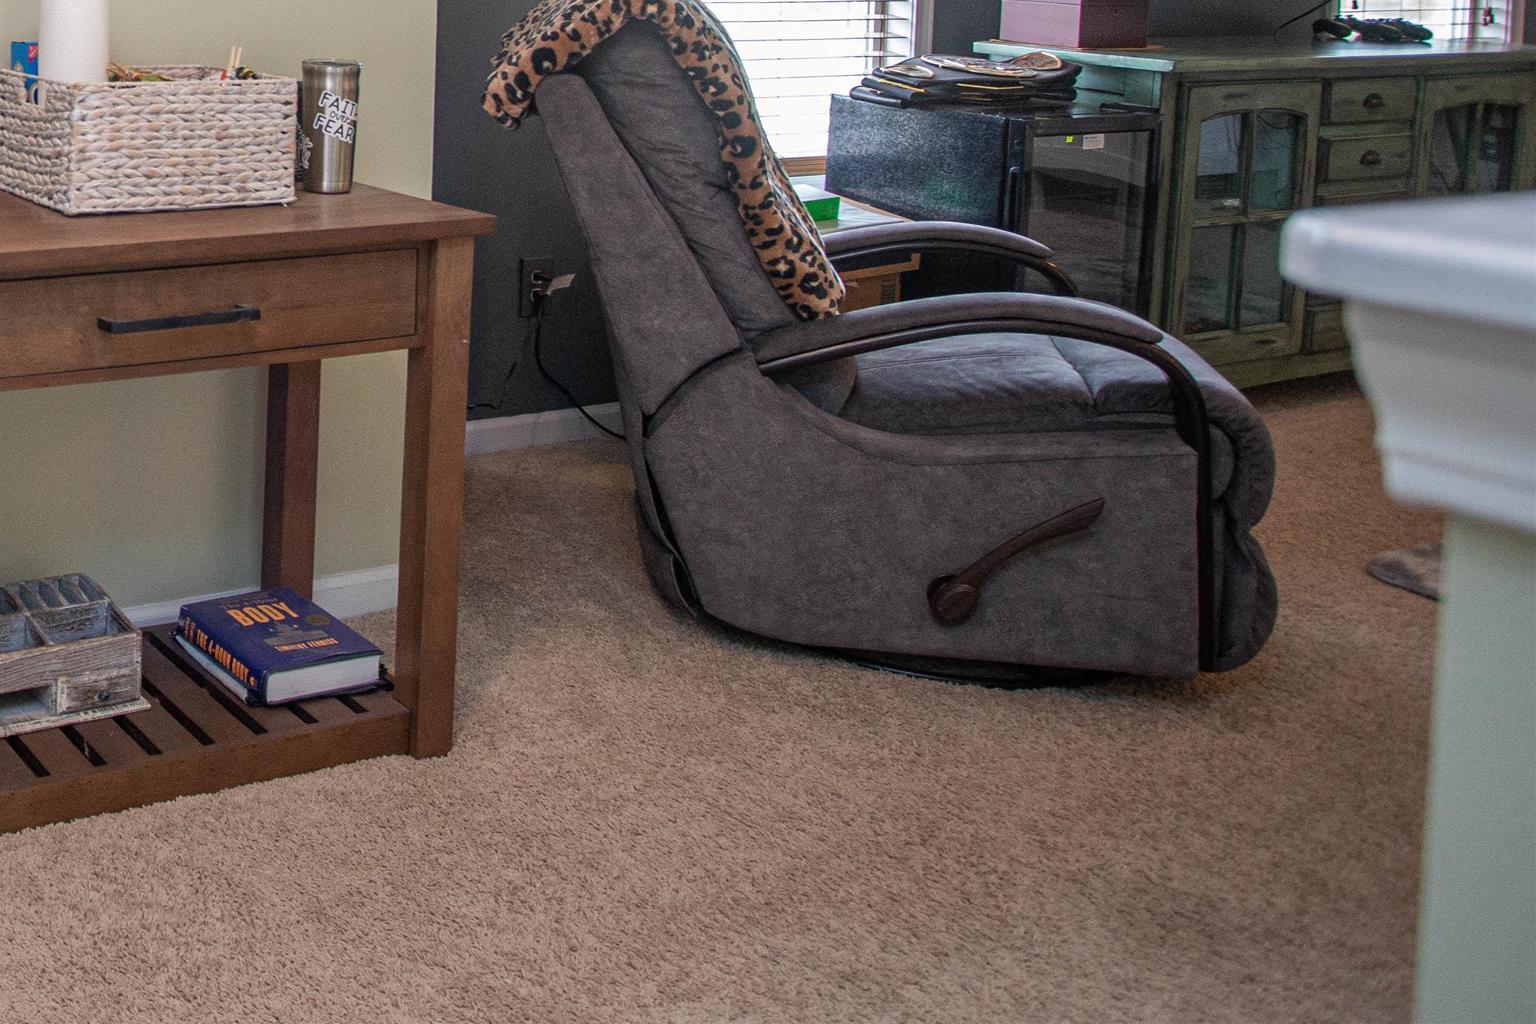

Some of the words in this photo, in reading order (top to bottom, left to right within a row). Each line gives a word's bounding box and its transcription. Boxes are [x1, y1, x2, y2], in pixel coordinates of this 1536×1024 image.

[315, 114, 354, 142] FEAR
[226, 601, 299, 627] BODY
[197, 629, 208, 651] THE
[232, 657, 250, 683] BODY
